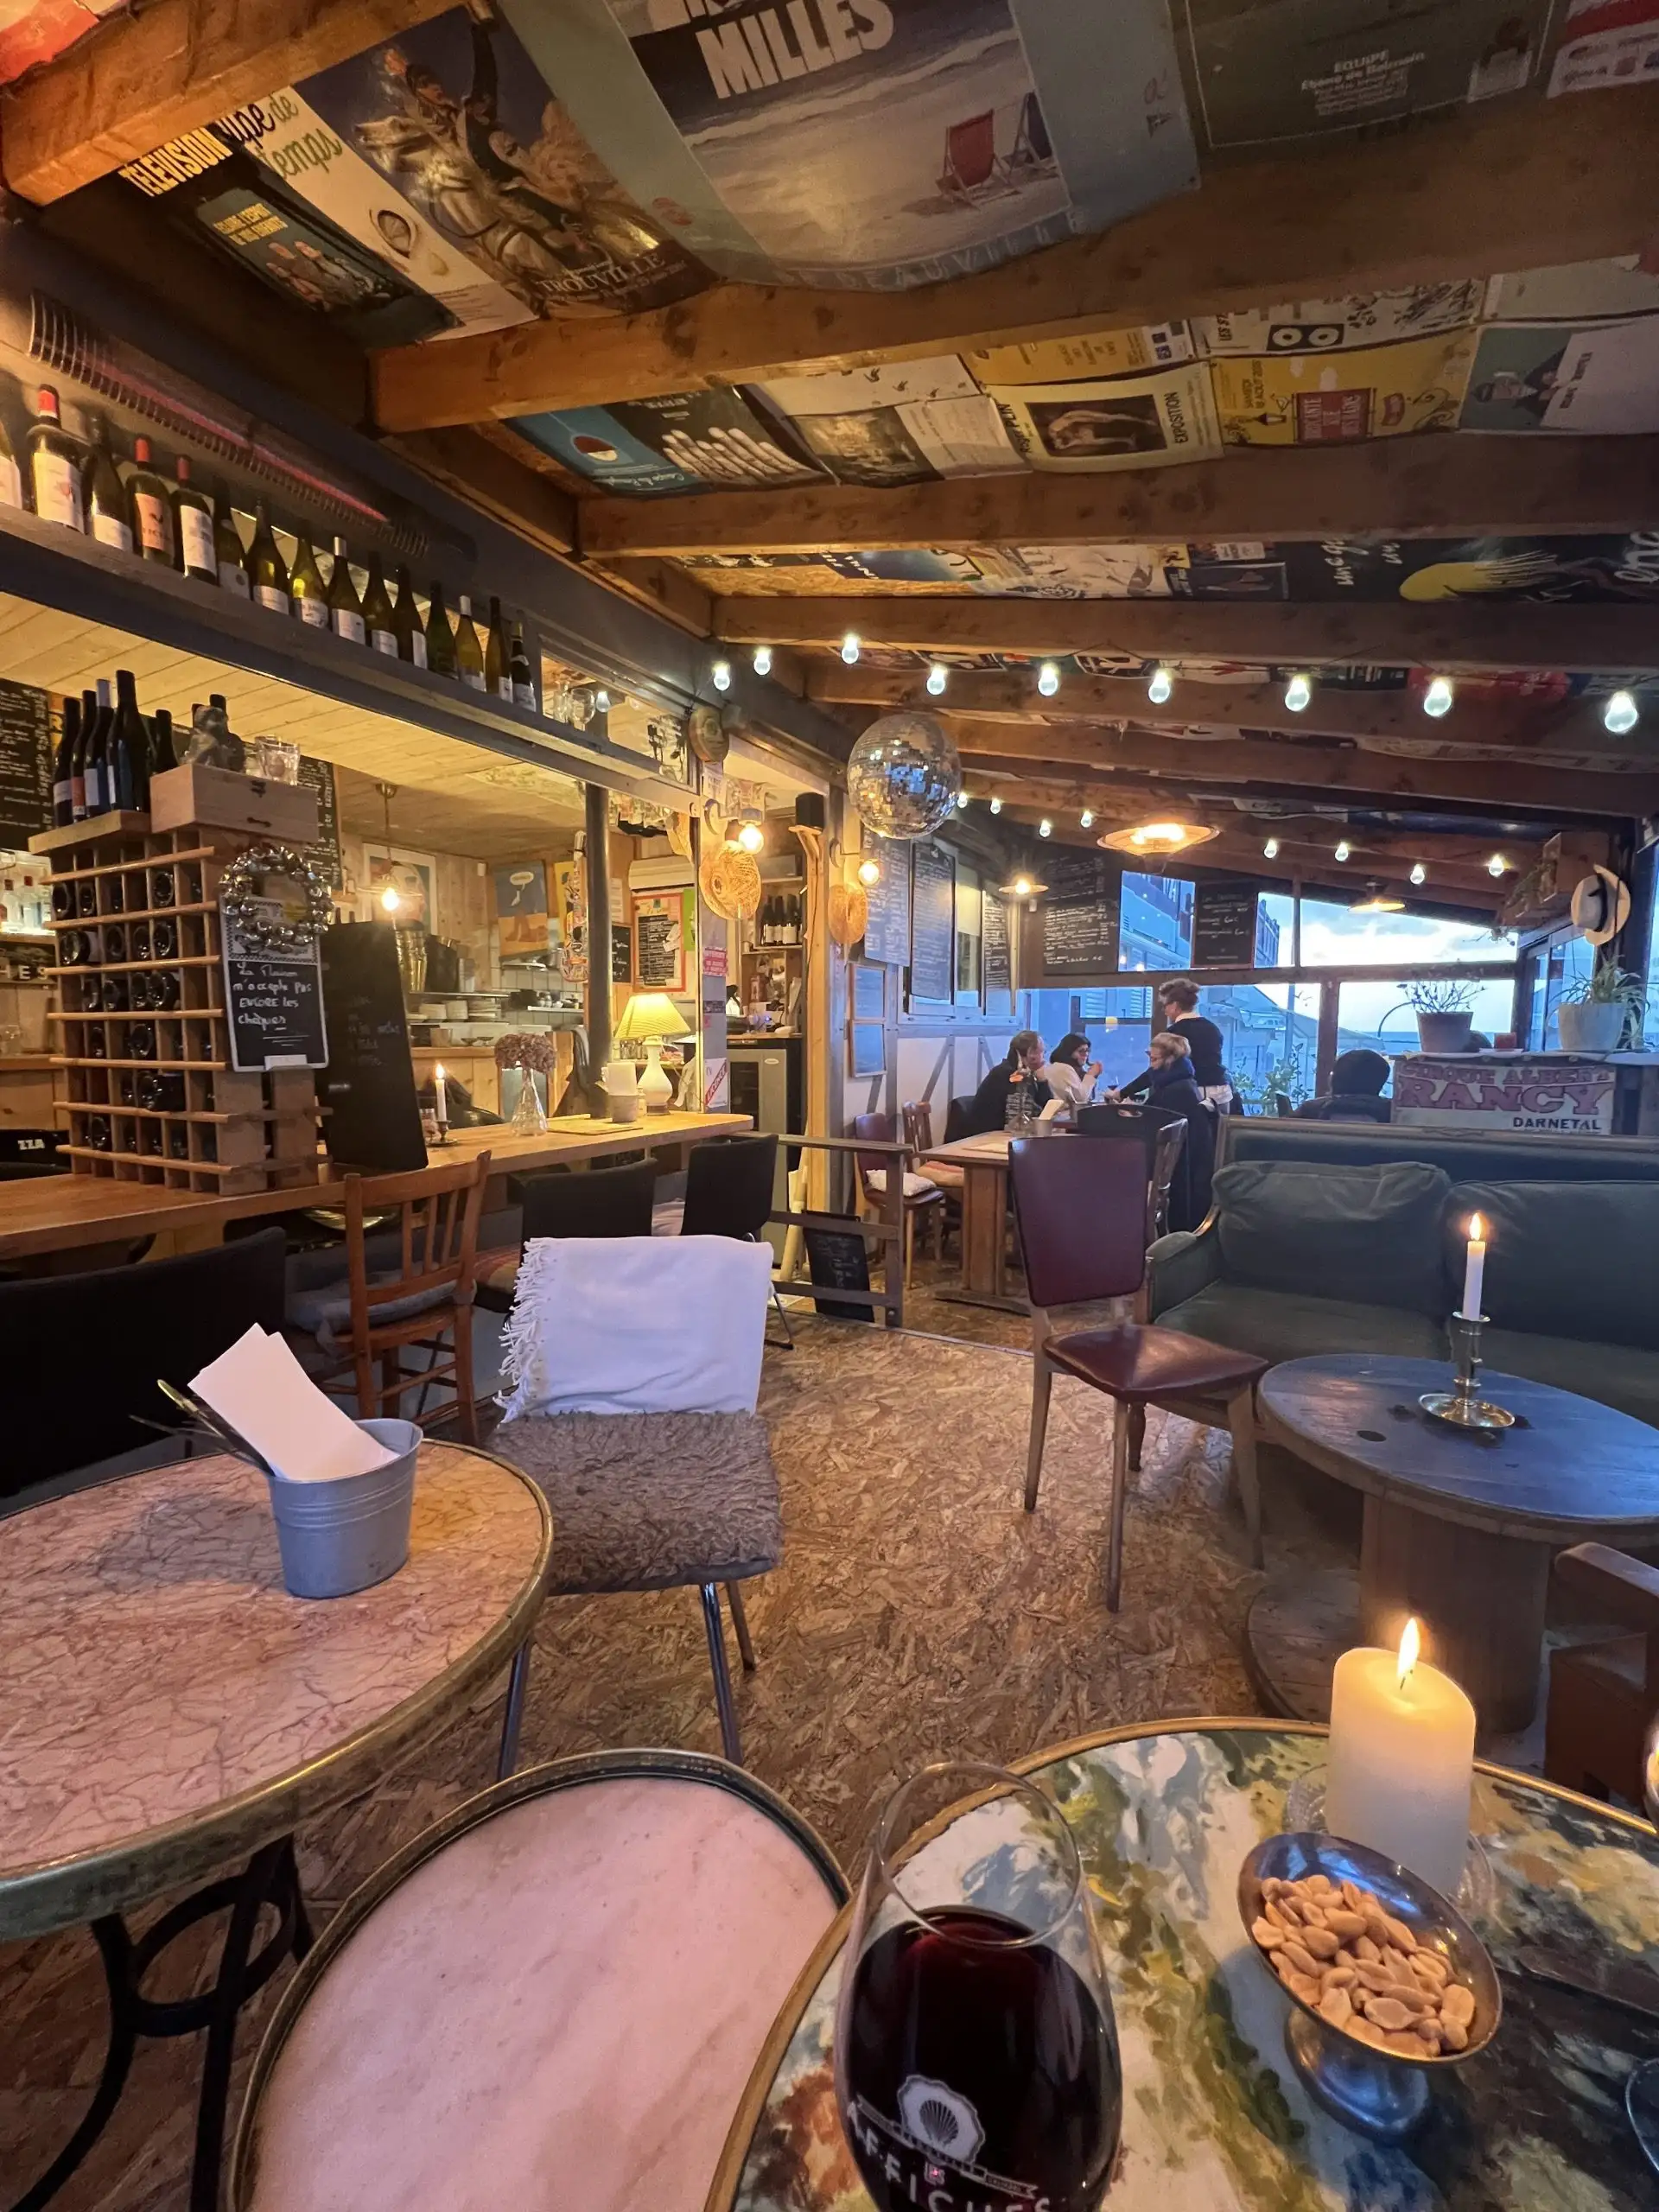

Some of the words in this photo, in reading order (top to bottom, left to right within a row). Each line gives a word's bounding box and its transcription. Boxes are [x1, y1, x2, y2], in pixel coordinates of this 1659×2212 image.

[696, 0, 894, 99] MILLES
[1164, 391, 1190, 445] EXPOSITION
[1396, 1077, 1615, 1116] RANCY
[1512, 1116, 1601, 1131] DARNETAL
